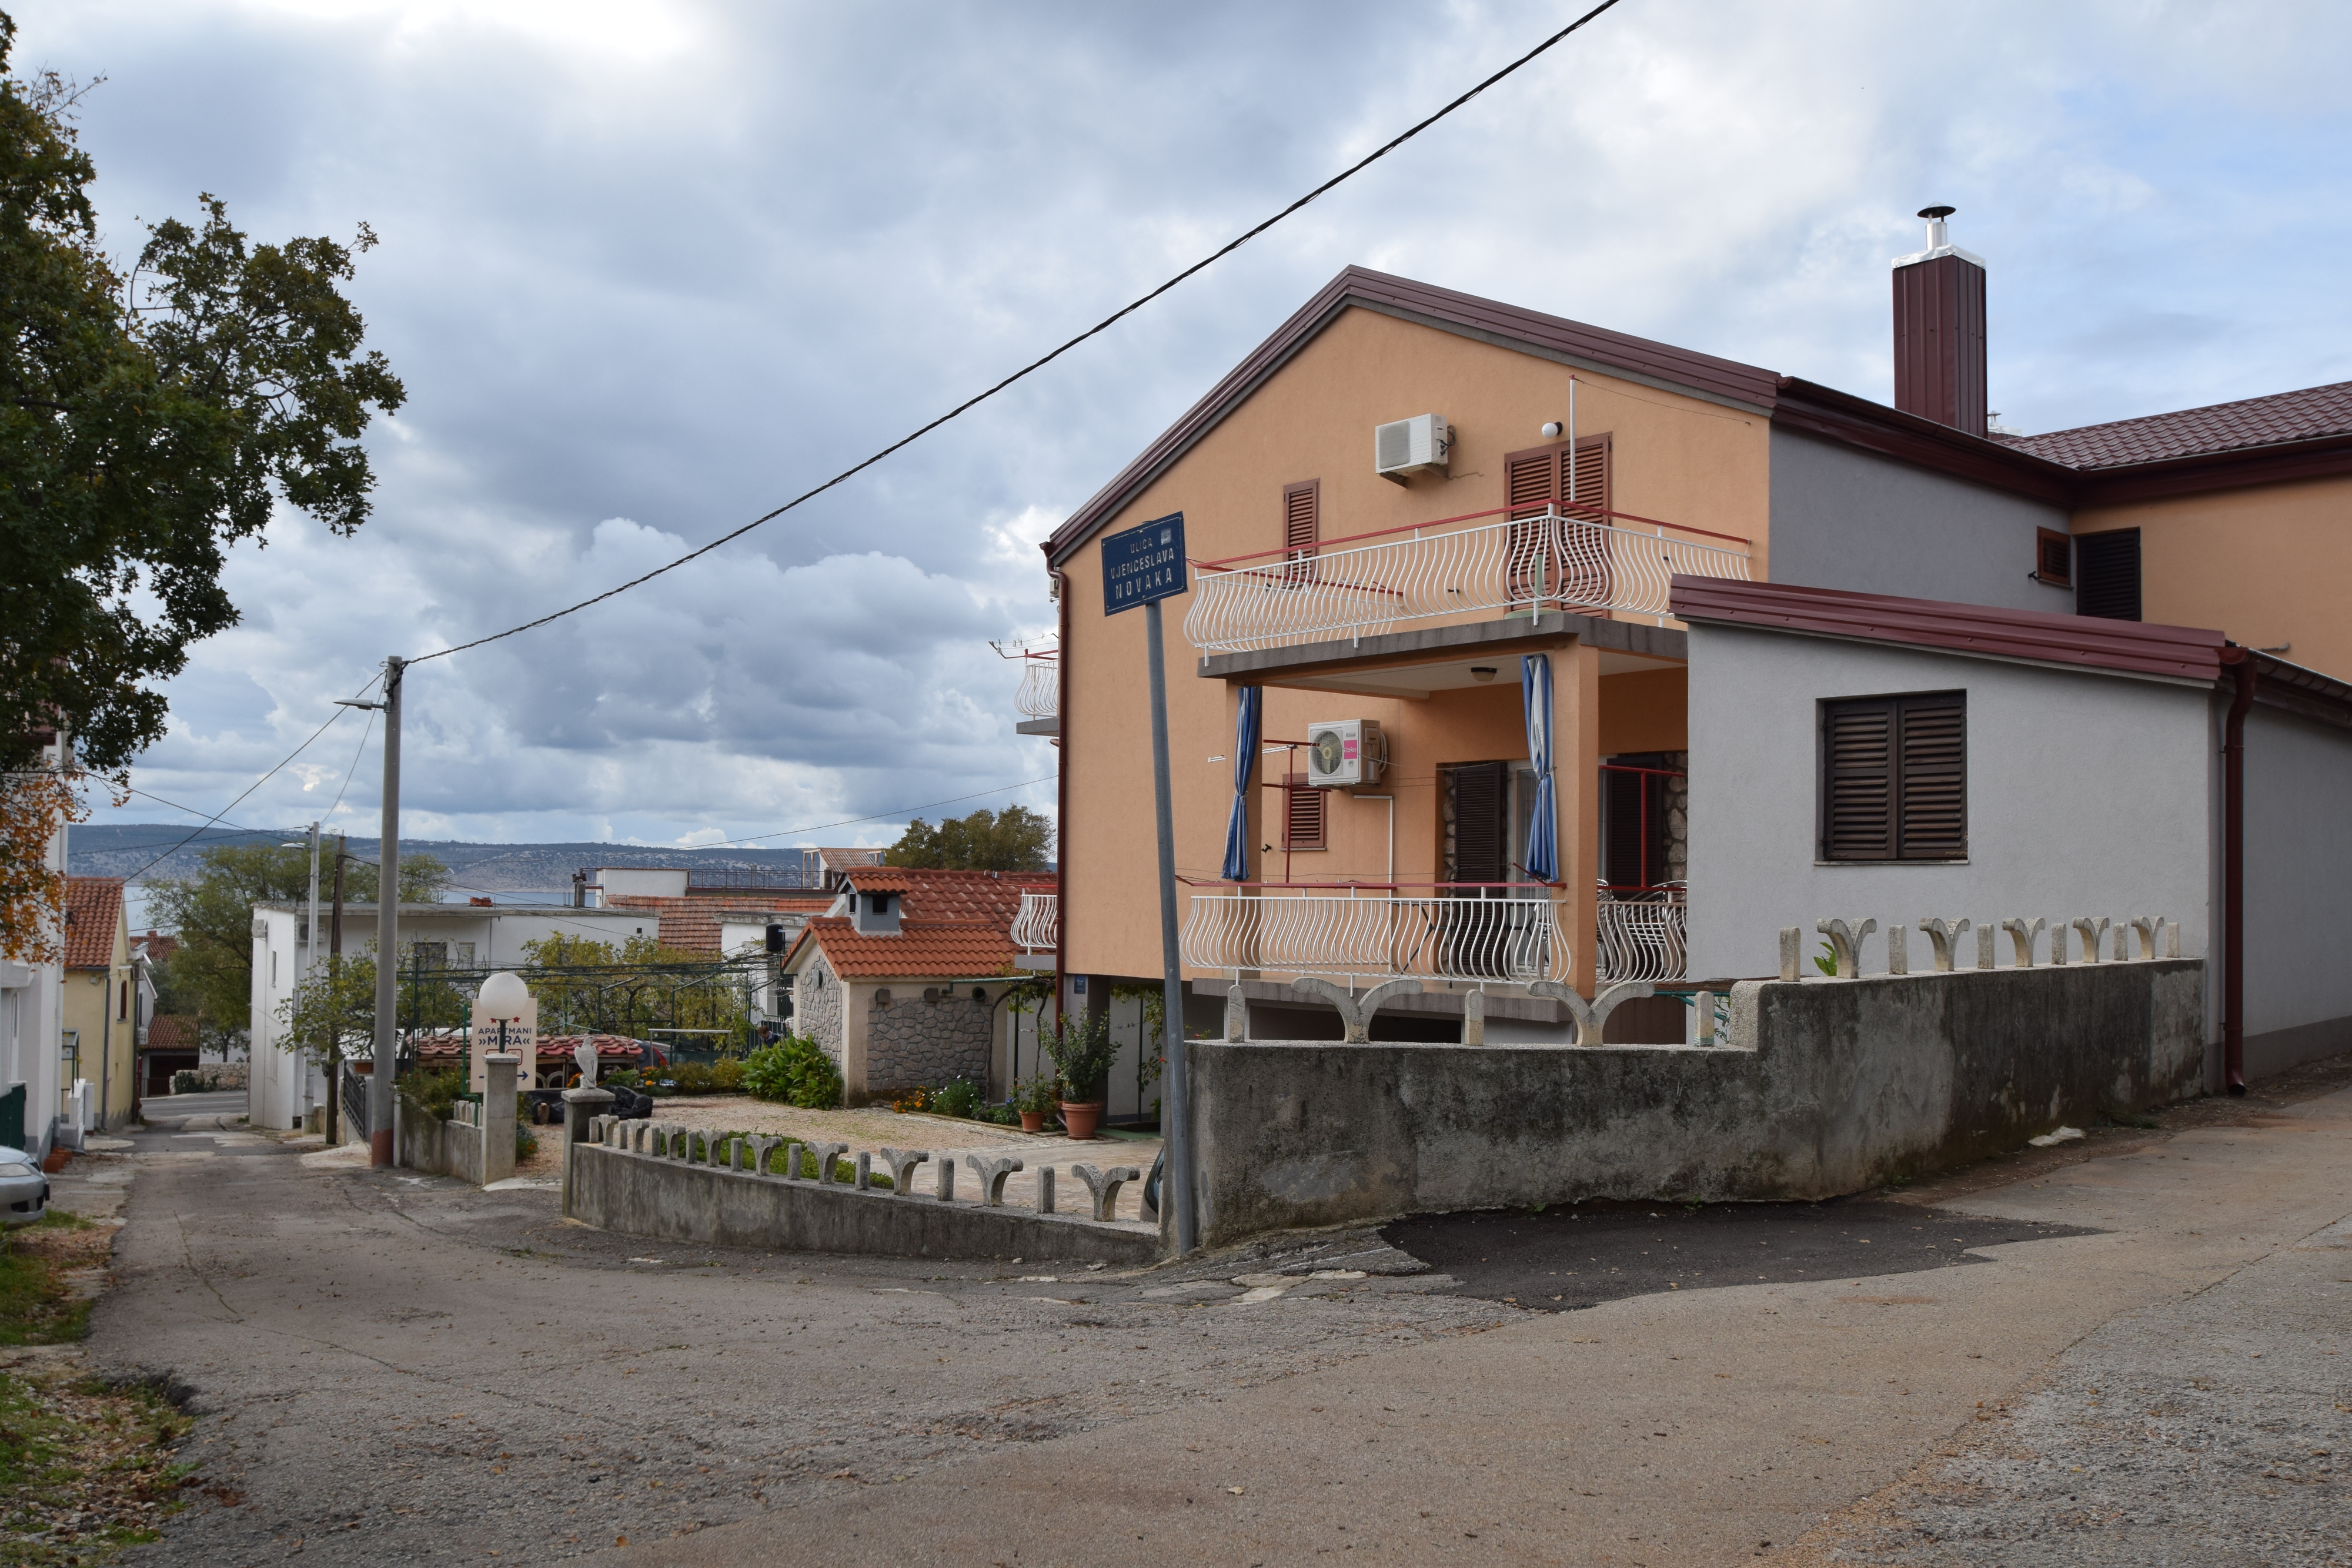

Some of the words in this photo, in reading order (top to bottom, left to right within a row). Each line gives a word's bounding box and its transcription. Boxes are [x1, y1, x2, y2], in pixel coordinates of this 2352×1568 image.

[1130, 538, 1152, 553] ULICA
[1111, 548, 1174, 579] VJENCESLAVA
[1115, 568, 1172, 599] NOVAKA
[479, 1035, 530, 1045] »MRA«
